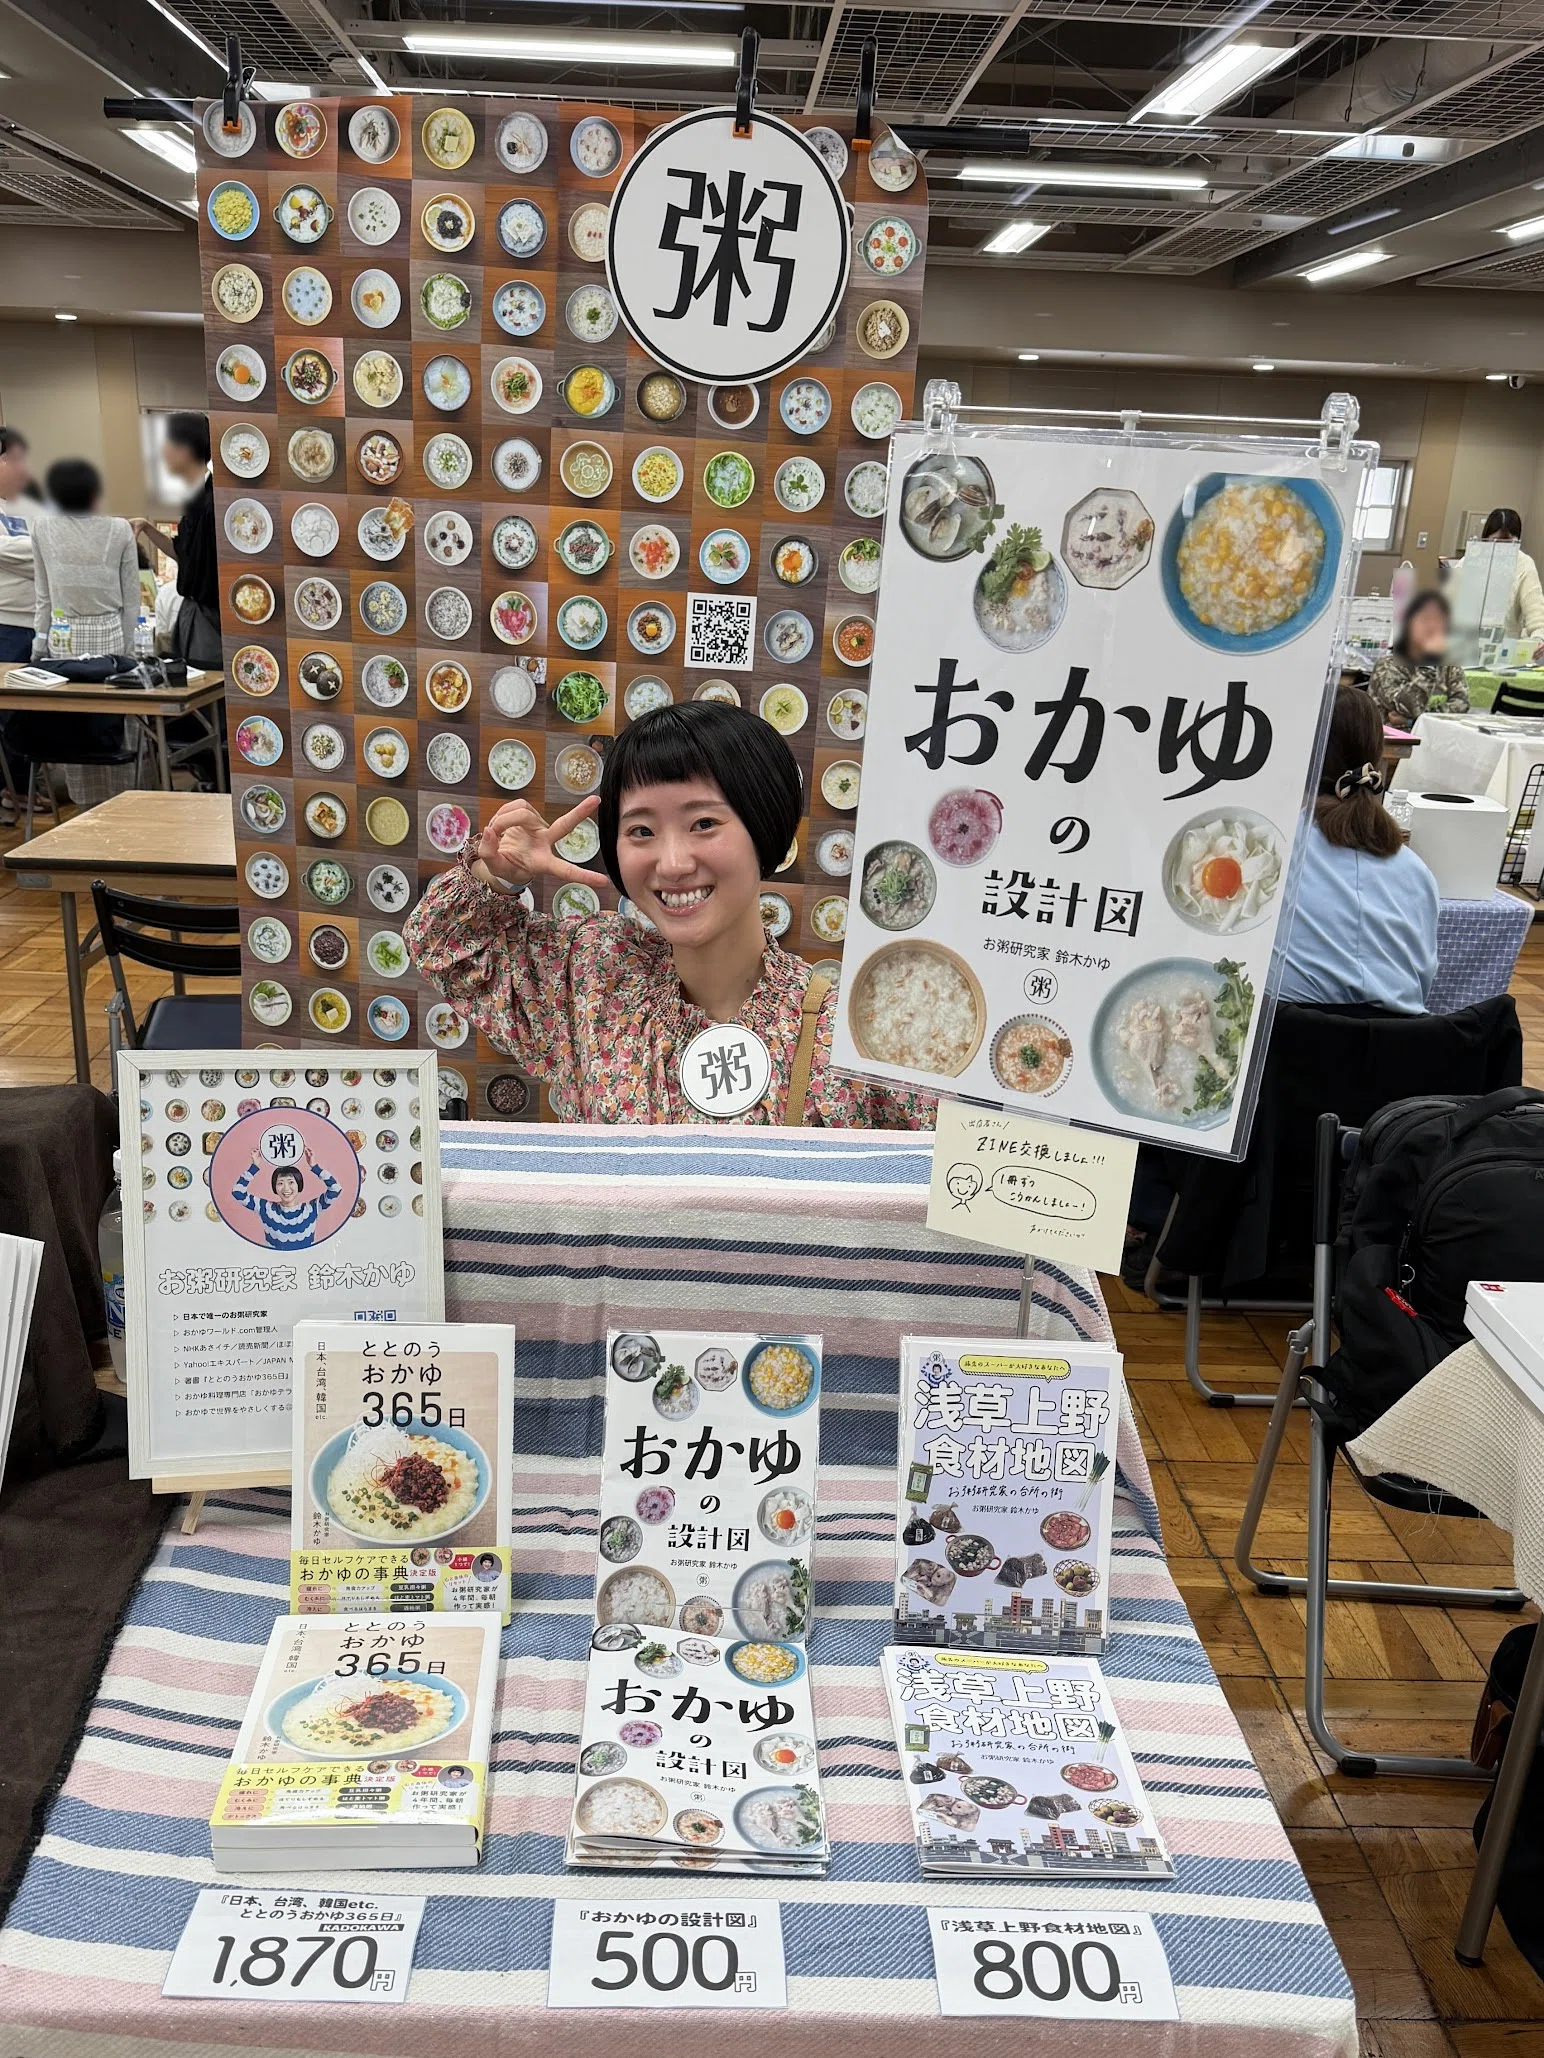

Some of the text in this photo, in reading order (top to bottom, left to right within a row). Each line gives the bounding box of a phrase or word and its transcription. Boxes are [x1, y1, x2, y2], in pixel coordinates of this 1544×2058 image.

[652, 167, 803, 333] 粥
[904, 657, 1273, 802] おかゆ
[1048, 814, 1090, 853] の
[981, 870, 1145, 938] 設計図
[983, 937, 1111, 971] お粥研究家 鈴木かゆ
[1029, 975, 1052, 999] 粥
[697, 1042, 752, 1101] 粥
[268, 1133, 296, 1159] 粥
[158, 1261, 416, 1295] お粥研究家 鈴木かゆ
[183, 1310, 268, 1321] 日本で唯一のお粥研究家
[183, 1326, 278, 1337] おかゆワールド.com管理人
[362, 1341, 441, 1357] ととのう
[184, 1373, 289, 1385] 著書『ととのうおかゆ365日』
[362, 1363, 442, 1385] おかゆ
[185, 1404, 285, 1417] おかゆで世界をやさしくする
[362, 1391, 466, 1428] 365日
[913, 1380, 1110, 1438] 浅草上野
[620, 1425, 801, 1485] おかゆ
[923, 1433, 1096, 1483] 食材地図
[700, 1495, 721, 1514] の
[948, 1485, 1063, 1500] お粥研究家の台所の街
[1010, 1506, 1039, 1515] 鈴木かゆ
[313, 1511, 321, 1545] 鈴木かゆ
[667, 1523, 750, 1551] 設計図
[299, 1555, 409, 1565] 毎日セルフケアできる
[670, 1559, 738, 1570] お粥研究家 鈴木かゆ
[300, 1565, 437, 1582] おかゆの事典 決定版
[344, 1620, 426, 1632] ととのう
[339, 1633, 425, 1649] おかゆ
[334, 1651, 446, 1677] 365日
[897, 1668, 1100, 1712] 浅草上野
[601, 1679, 795, 1733] おかゆ
[915, 1702, 1100, 1742] 食材地図
[690, 1733, 712, 1748] の
[655, 1750, 747, 1780] 設計図
[234, 1774, 361, 1786] おかゆの事典
[660, 1776, 701, 1788] お粥研究家
[221, 1895, 379, 1910] 『日本、台湾、韓国etc.
[240, 1908, 404, 1922] ととのうおかゆ365日』
[580, 1910, 757, 1928] 『おかゆの設計図』
[322, 1924, 401, 1932] KADOKAWA
[941, 1919, 1142, 1936] 『浅草上野食材地図』
[212, 1935, 397, 1993] 1,870円
[591, 1931, 757, 1992] 500円
[973, 1939, 1143, 2004] 800円
